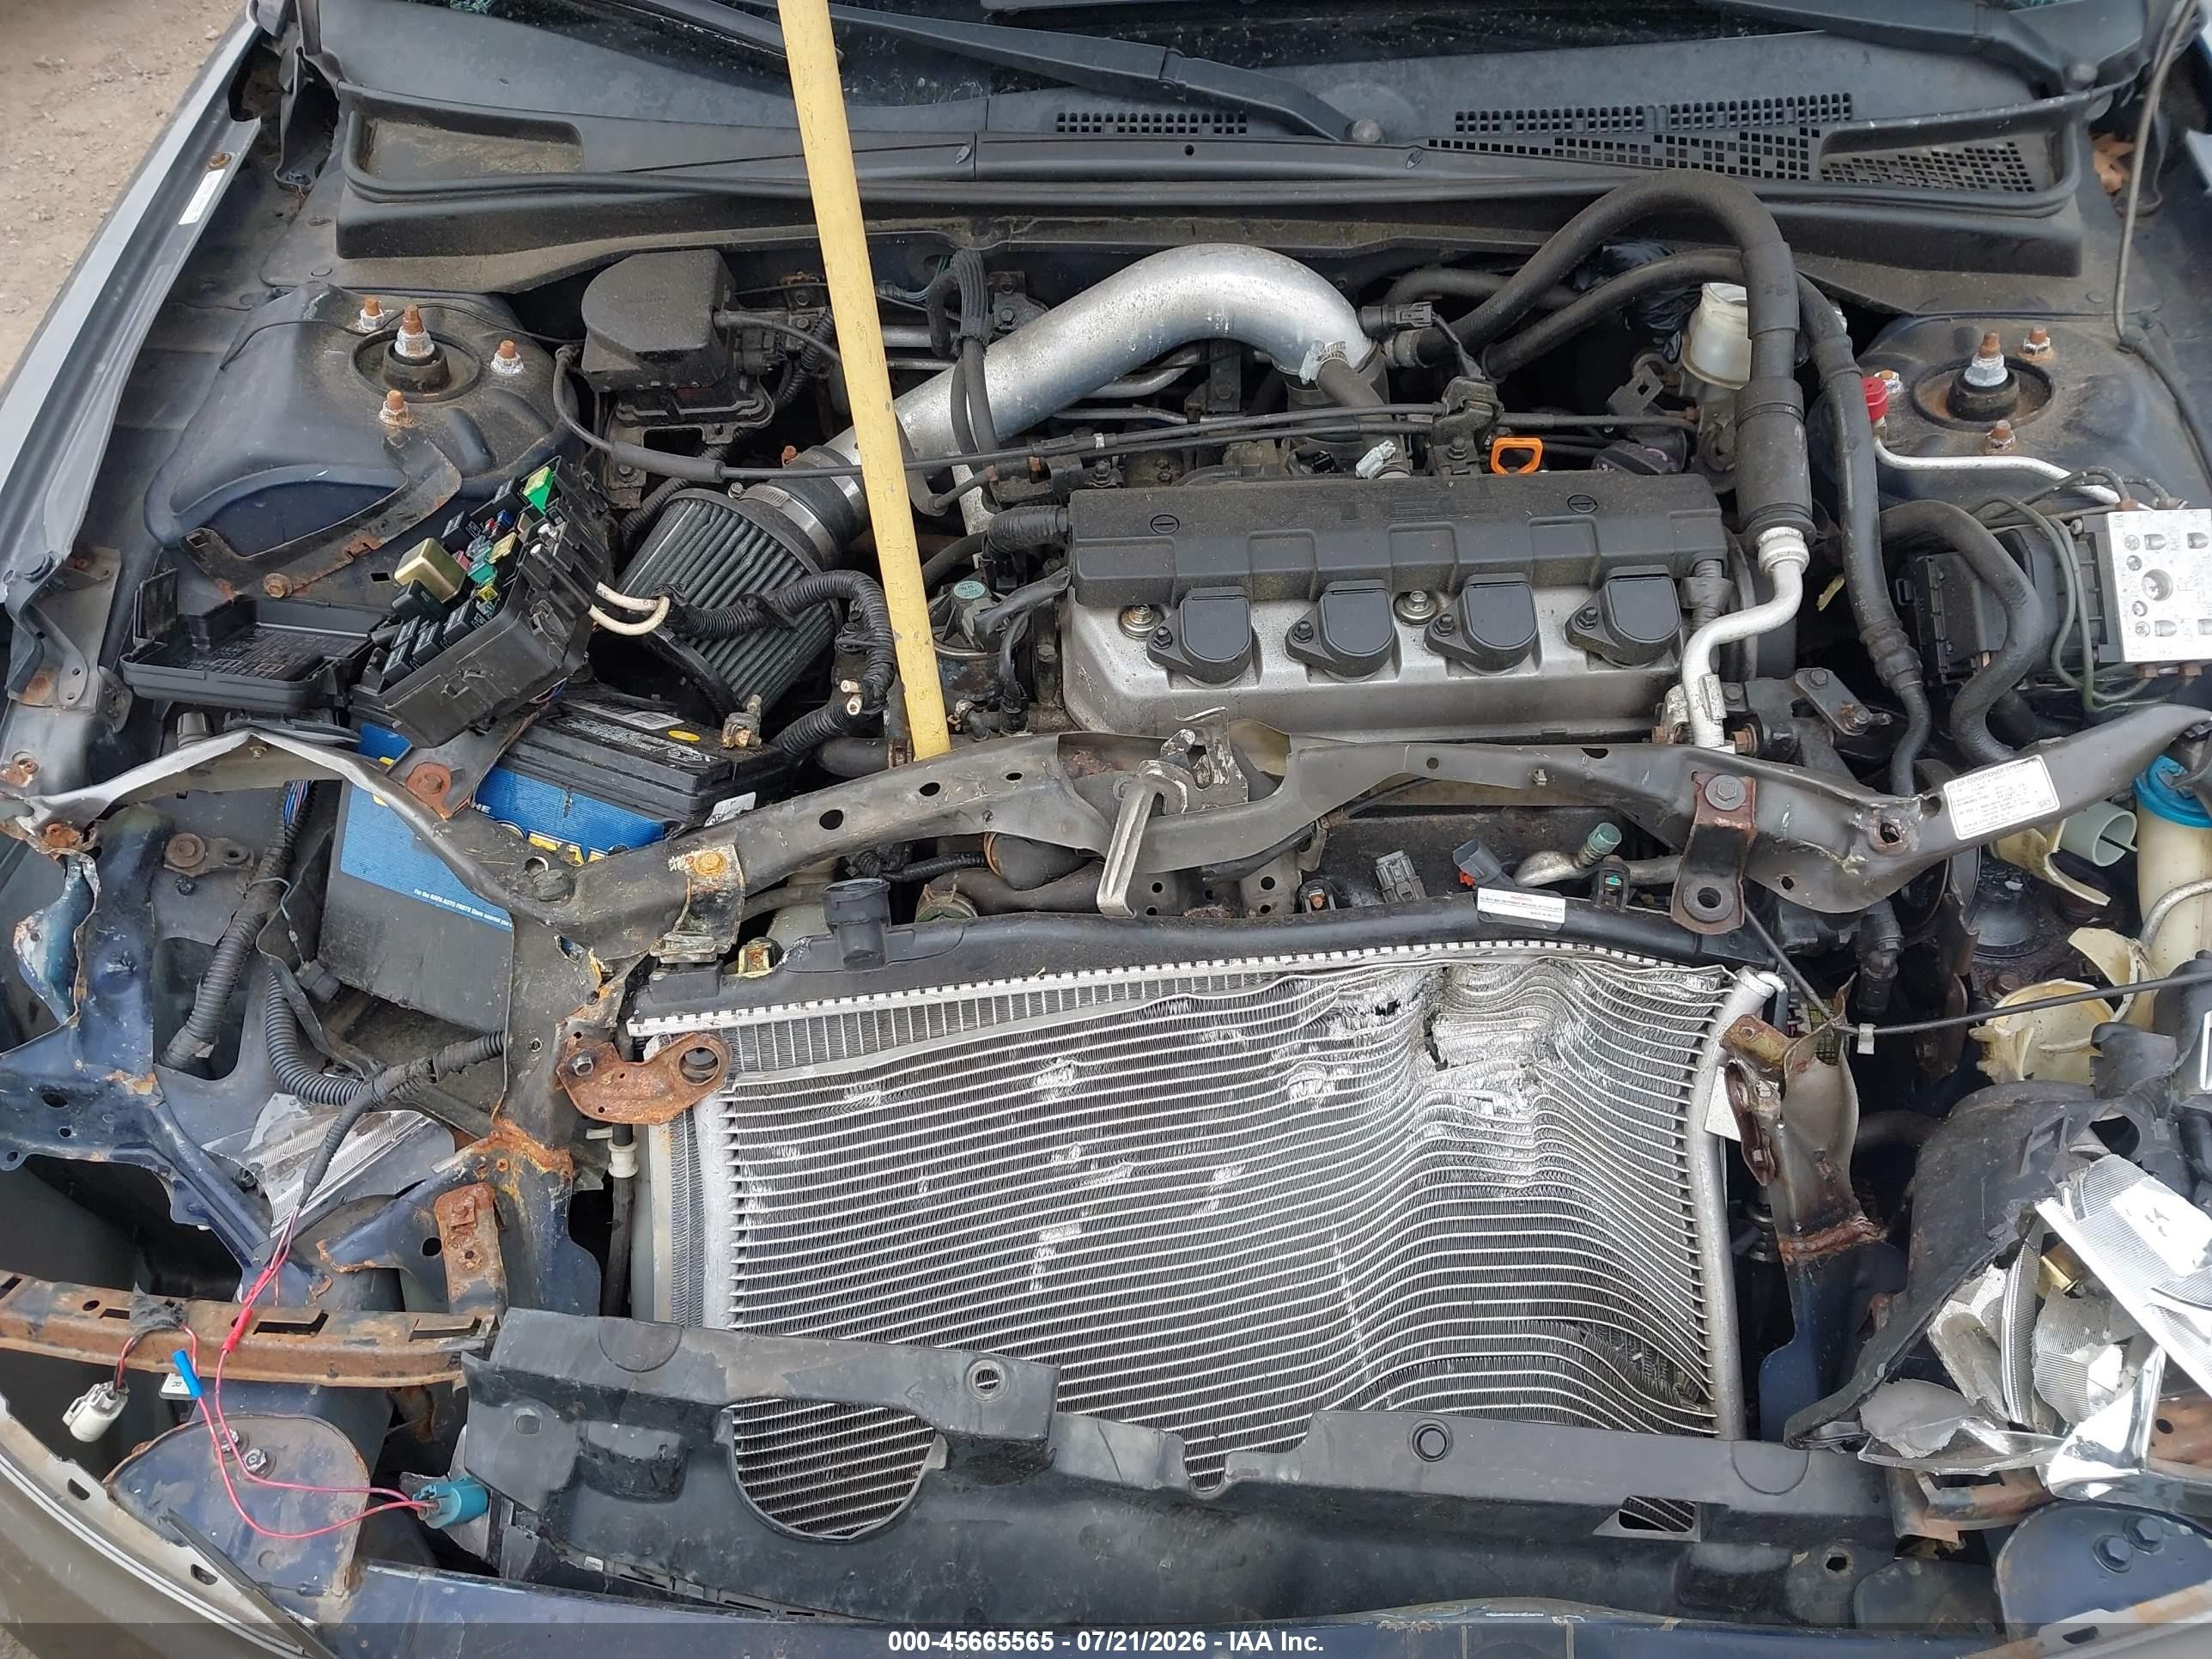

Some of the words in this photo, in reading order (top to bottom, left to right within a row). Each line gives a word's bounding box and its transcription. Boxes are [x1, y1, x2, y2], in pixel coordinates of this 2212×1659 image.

[430, 894, 443, 902] NAPA
[443, 898, 456, 908] AUTO
[456, 902, 471, 912] PARTS
